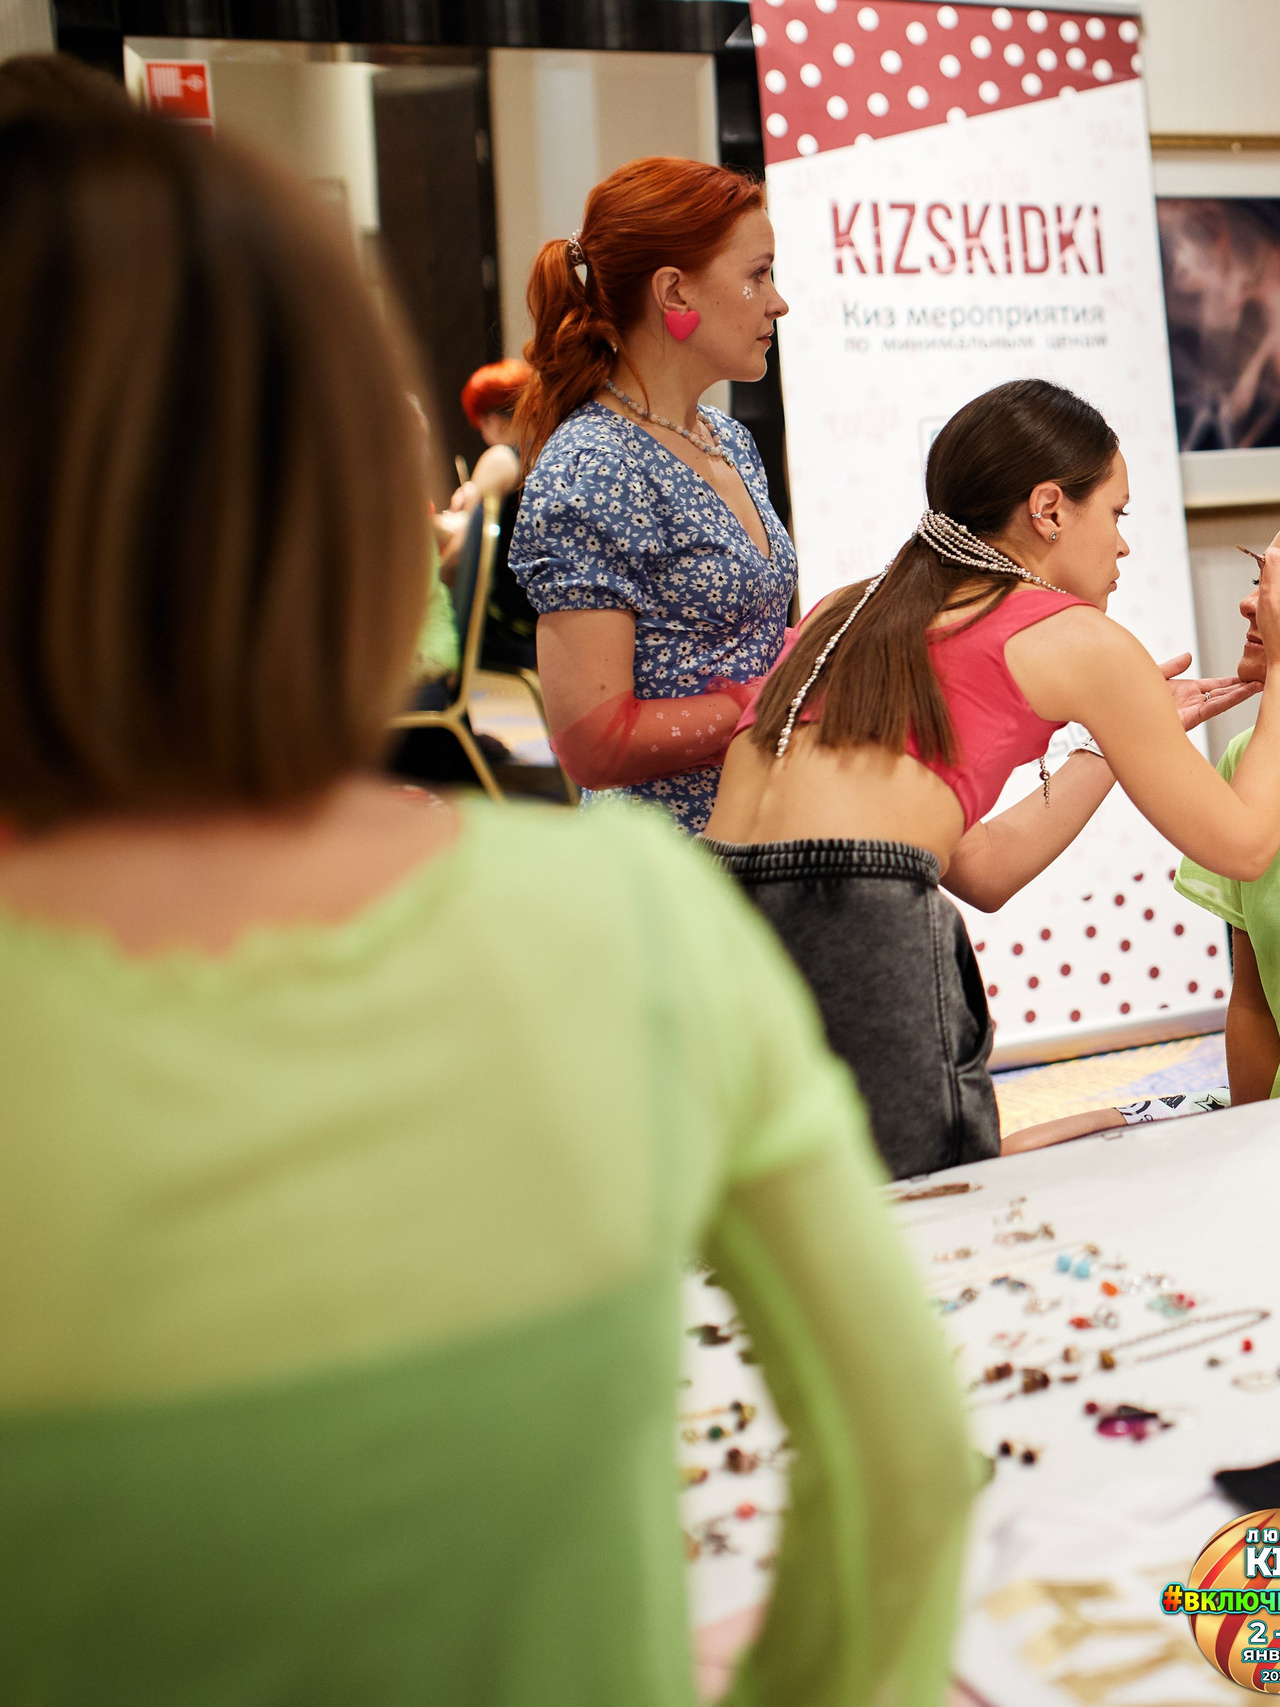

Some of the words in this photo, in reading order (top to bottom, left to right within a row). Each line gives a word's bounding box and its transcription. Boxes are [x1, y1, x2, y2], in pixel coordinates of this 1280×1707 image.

[831, 200, 1104, 274] KIZSKIDKI
[842, 302, 895, 328] Киз
[907, 305, 1106, 331] мероприятия
[844, 336, 870, 351] по
[881, 335, 1034, 352] минимальным
[1045, 335, 1107, 351] ценам
